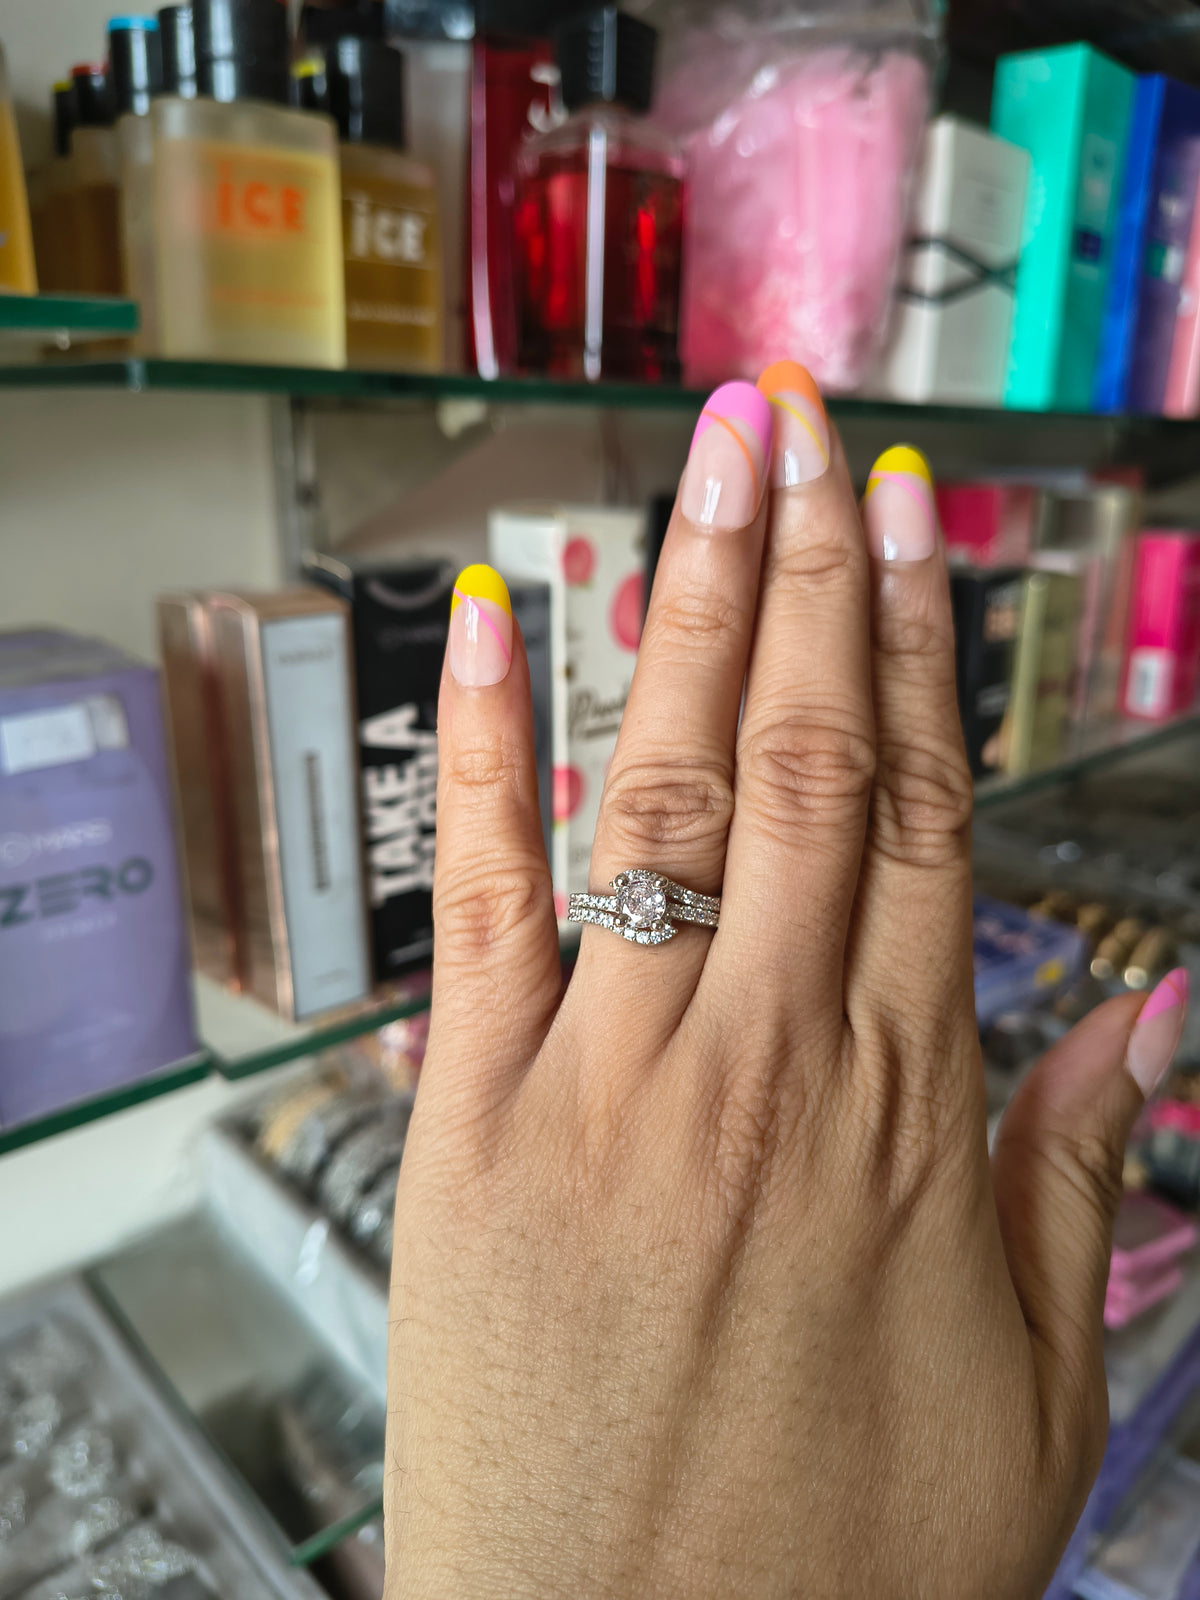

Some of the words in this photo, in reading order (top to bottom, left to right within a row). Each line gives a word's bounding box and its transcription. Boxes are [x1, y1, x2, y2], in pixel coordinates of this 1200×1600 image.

[362, 703, 420, 749] A
[364, 763, 420, 908] TAKE
[0, 855, 154, 930] ZERO
